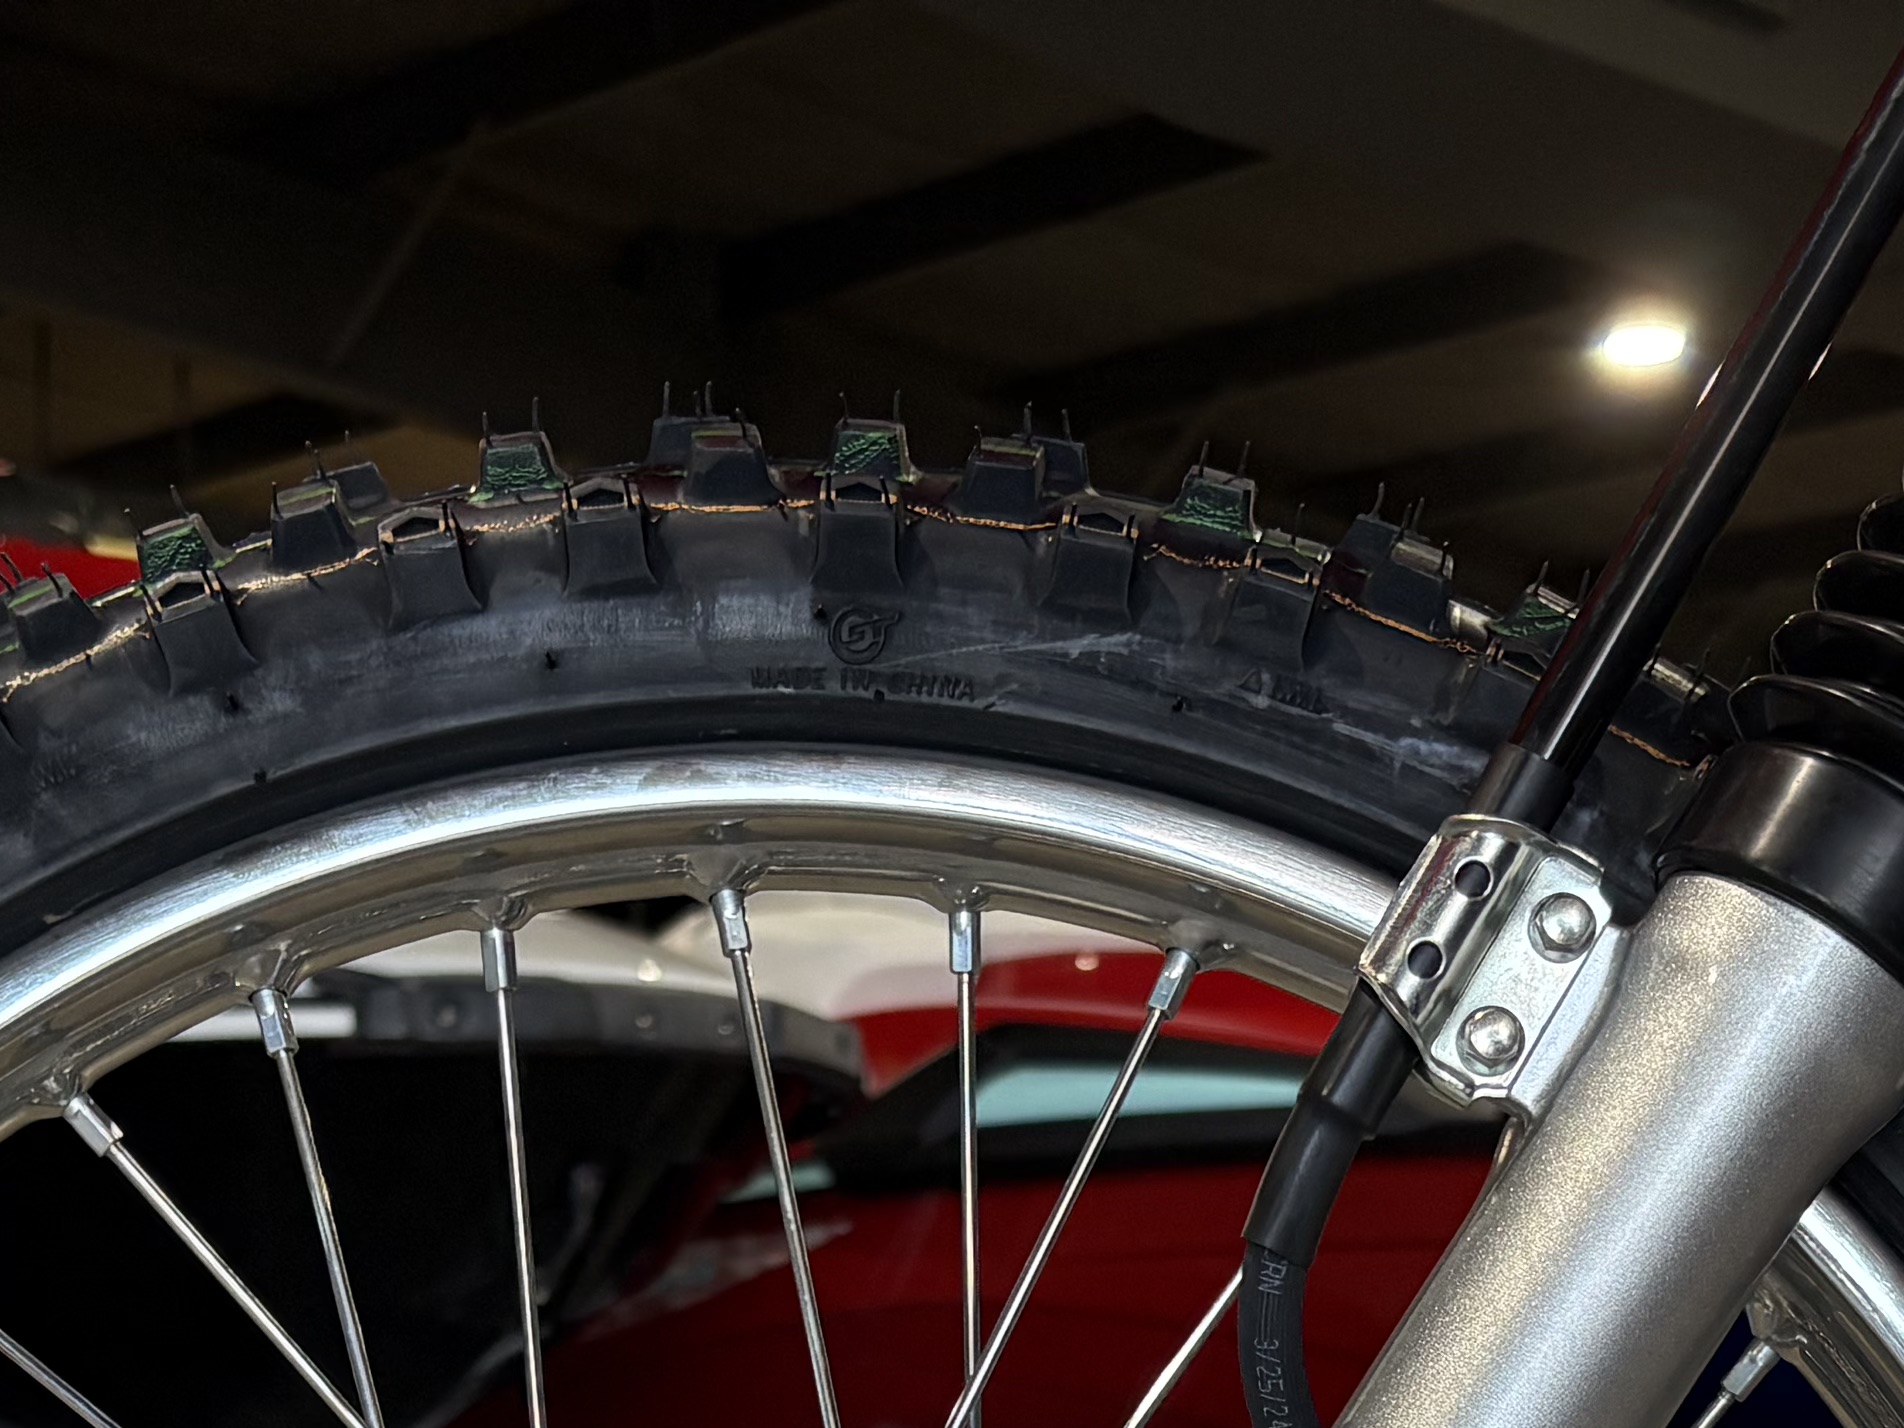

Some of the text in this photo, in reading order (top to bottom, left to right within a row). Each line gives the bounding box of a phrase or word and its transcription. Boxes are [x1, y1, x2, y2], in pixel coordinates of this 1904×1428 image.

[751, 665, 977, 703] MADE IN CHINA
